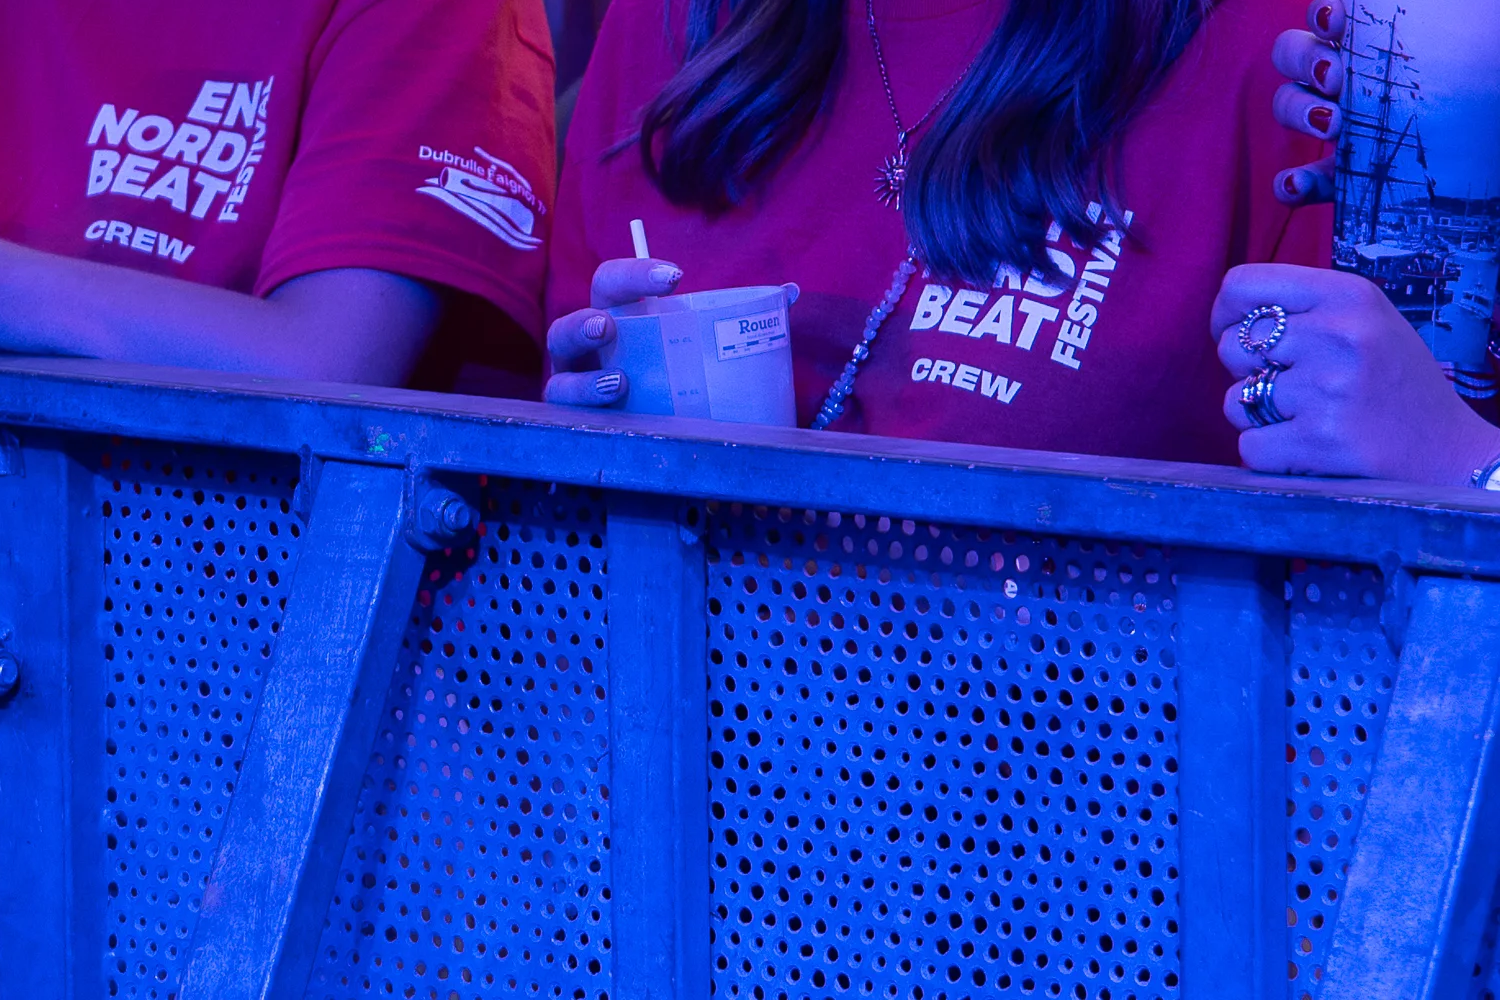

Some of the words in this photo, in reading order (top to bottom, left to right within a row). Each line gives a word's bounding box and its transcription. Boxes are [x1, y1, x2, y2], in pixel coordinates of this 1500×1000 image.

[187, 79, 264, 129] EN
[86, 103, 248, 174] NORD
[419, 145, 485, 176] Dubrulle
[86, 149, 232, 220] BEAT
[84, 219, 196, 264] CREW
[739, 316, 780, 335] Rouen
[909, 283, 1060, 351] BEAT
[910, 357, 1023, 405] CREW
